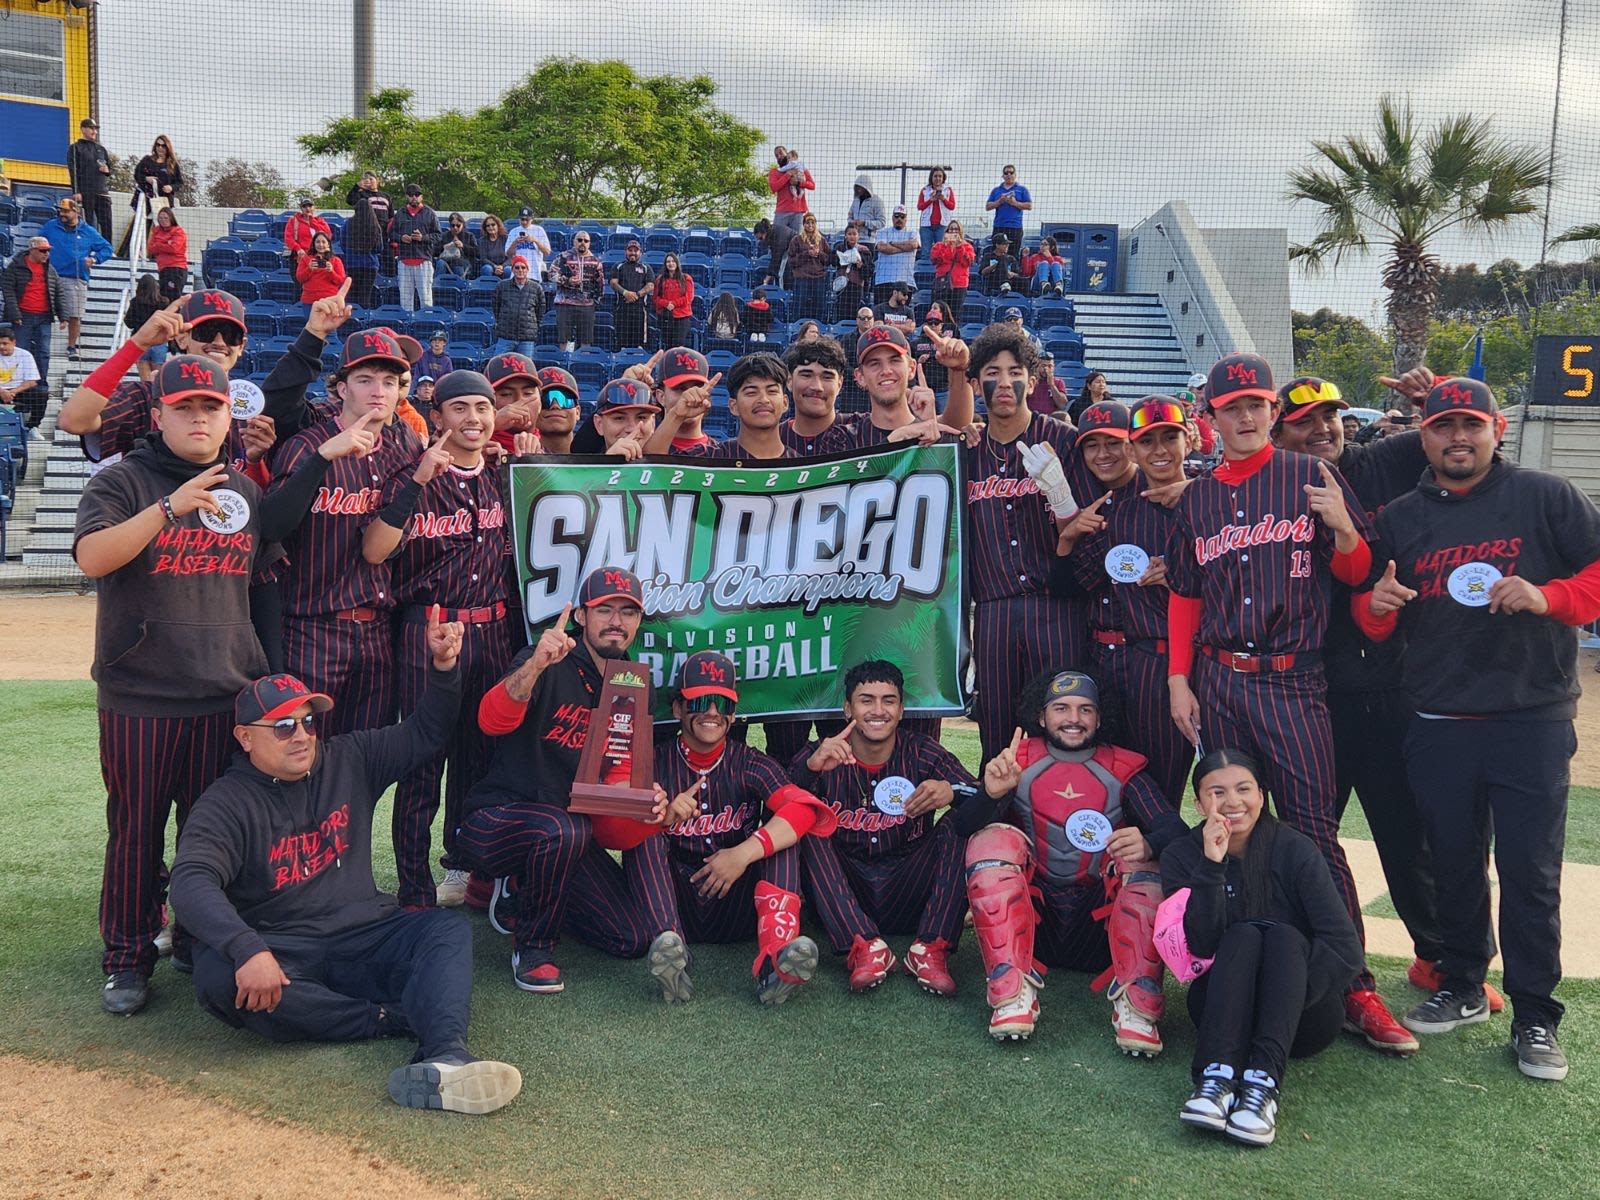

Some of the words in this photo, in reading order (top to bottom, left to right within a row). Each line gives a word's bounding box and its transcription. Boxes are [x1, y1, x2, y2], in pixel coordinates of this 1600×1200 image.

[204, 292, 232, 314] MM
[363, 333, 392, 356] MM
[868, 328, 891, 341] MM
[501, 355, 527, 373] MM
[675, 353, 699, 371] MM
[1562, 344, 1594, 398] 5
[180, 361, 214, 386] MM
[543, 368, 565, 384] MM
[1226, 362, 1258, 385] MM
[1440, 384, 1473, 405] MM
[1087, 406, 1112, 424] MM
[154, 526, 253, 552] MATADORS
[526, 492, 696, 624] SAN
[708, 473, 950, 595] DIEGO
[148, 552, 249, 577] BASEBALL
[1290, 549, 1312, 577] 13
[604, 570, 632, 592] MM
[713, 562, 902, 612] Champions
[644, 621, 796, 648] DIVISION
[822, 615, 833, 631] V
[700, 661, 725, 682] MM
[613, 713, 632, 724] CIF
